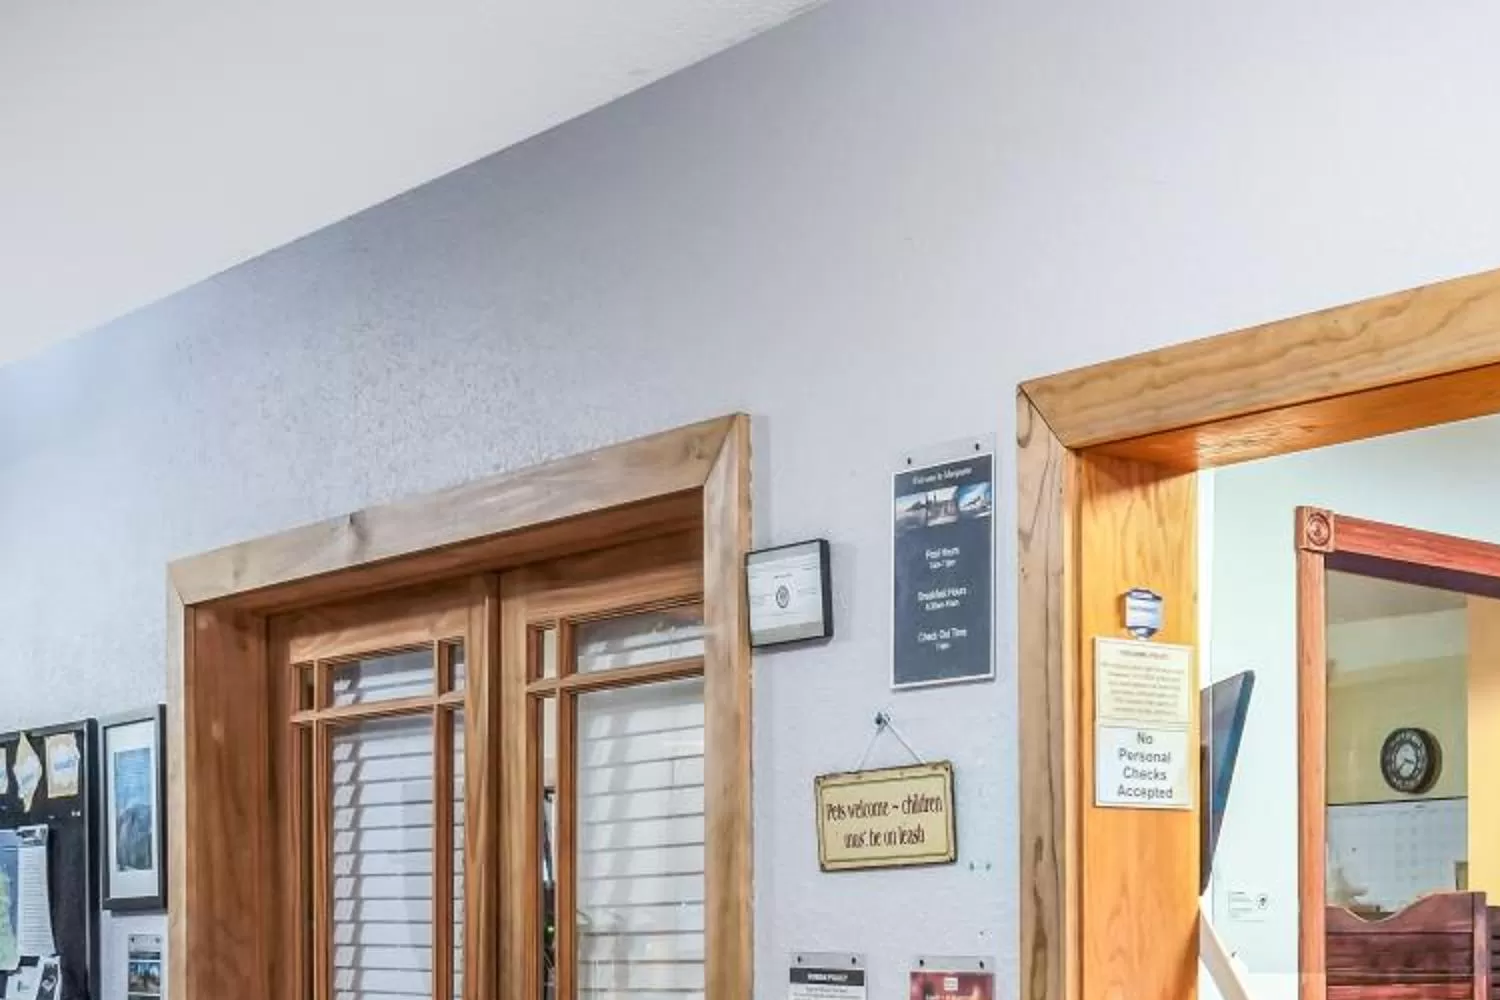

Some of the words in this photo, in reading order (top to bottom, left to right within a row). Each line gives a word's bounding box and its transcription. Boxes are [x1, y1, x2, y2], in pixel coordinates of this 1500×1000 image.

[1136, 731, 1153, 746] No
[1117, 747, 1172, 764] Personal
[1123, 767, 1168, 781] Checks
[1117, 783, 1174, 800] Accepted
[826, 803, 847, 821] Pets
[848, 800, 890, 818] welcome
[901, 794, 943, 815] children
[869, 826, 881, 847] be
[883, 829, 897, 847] on
[899, 823, 925, 845] leash
